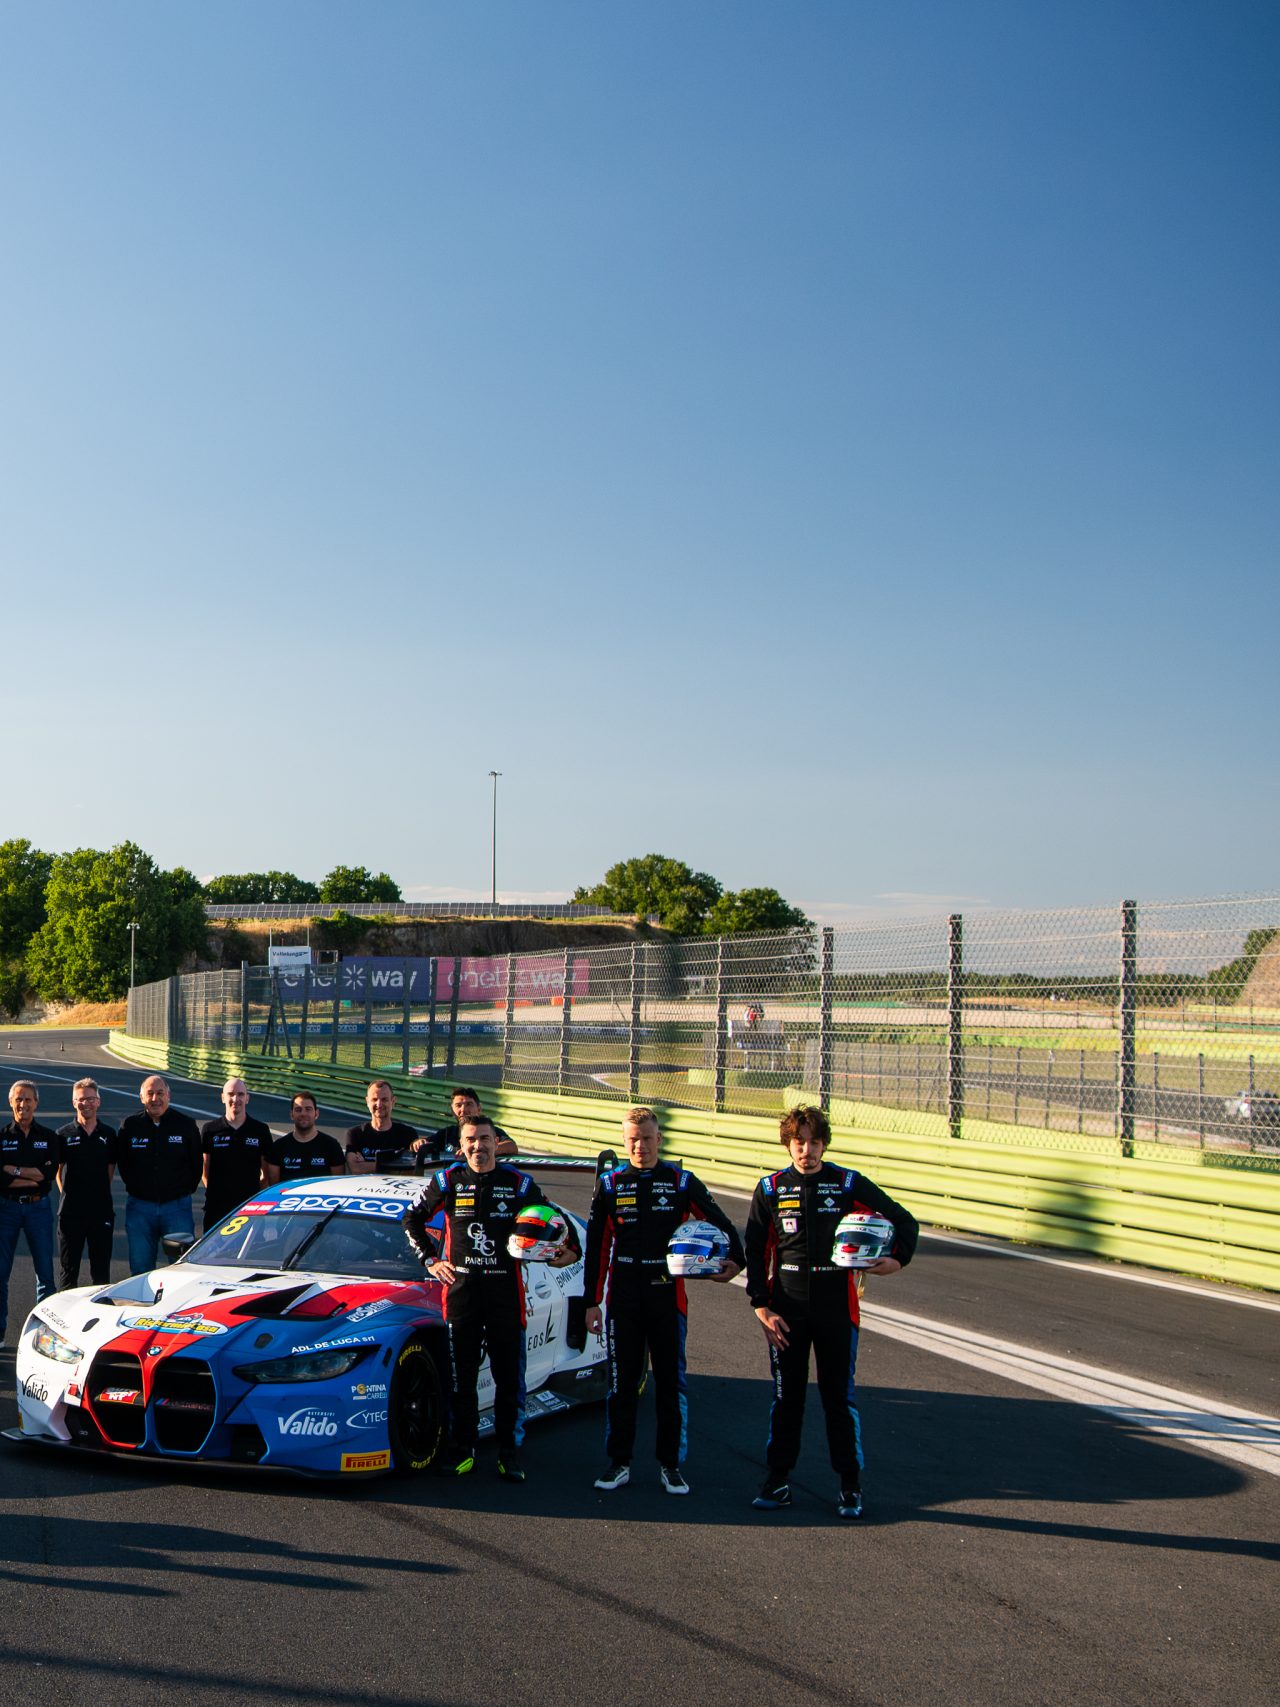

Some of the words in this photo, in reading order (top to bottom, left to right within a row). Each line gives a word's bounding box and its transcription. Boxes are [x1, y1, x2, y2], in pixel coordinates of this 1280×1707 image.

[274, 1196, 404, 1217] sparco
[220, 1216, 250, 1236] 8
[464, 1256, 498, 1265] PARFUM
[556, 1270, 570, 1288] BMW
[291, 1344, 313, 1354] ADL
[330, 1337, 361, 1346] LUCA
[399, 1344, 422, 1366] PIRELLI
[22, 1375, 48, 1402] Valido
[278, 1411, 338, 1436] Valido
[346, 1454, 387, 1468] PIRELLI
